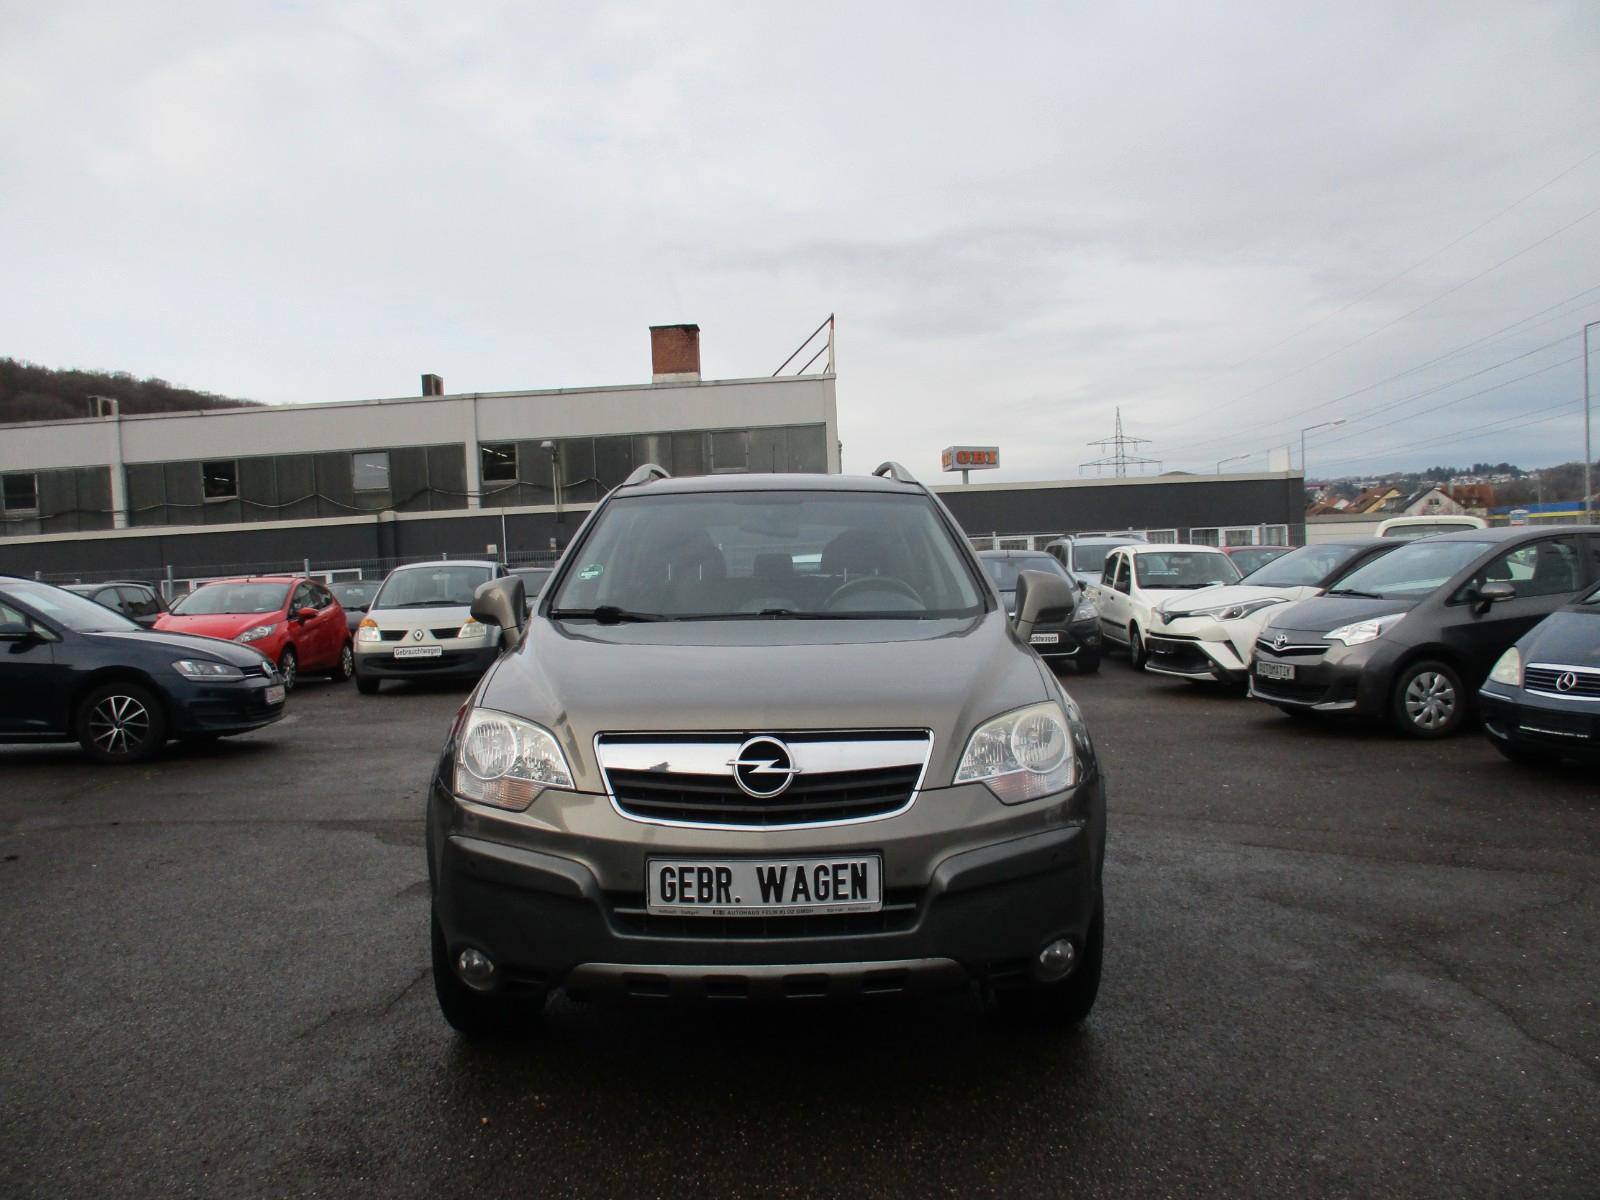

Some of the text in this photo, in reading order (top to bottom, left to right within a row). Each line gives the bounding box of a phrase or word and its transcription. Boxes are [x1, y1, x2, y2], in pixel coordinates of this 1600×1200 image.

[957, 450, 997, 464] OBI
[395, 648, 441, 656] Gebrauchtwagen
[660, 862, 868, 904] GEBR. WAGEN
